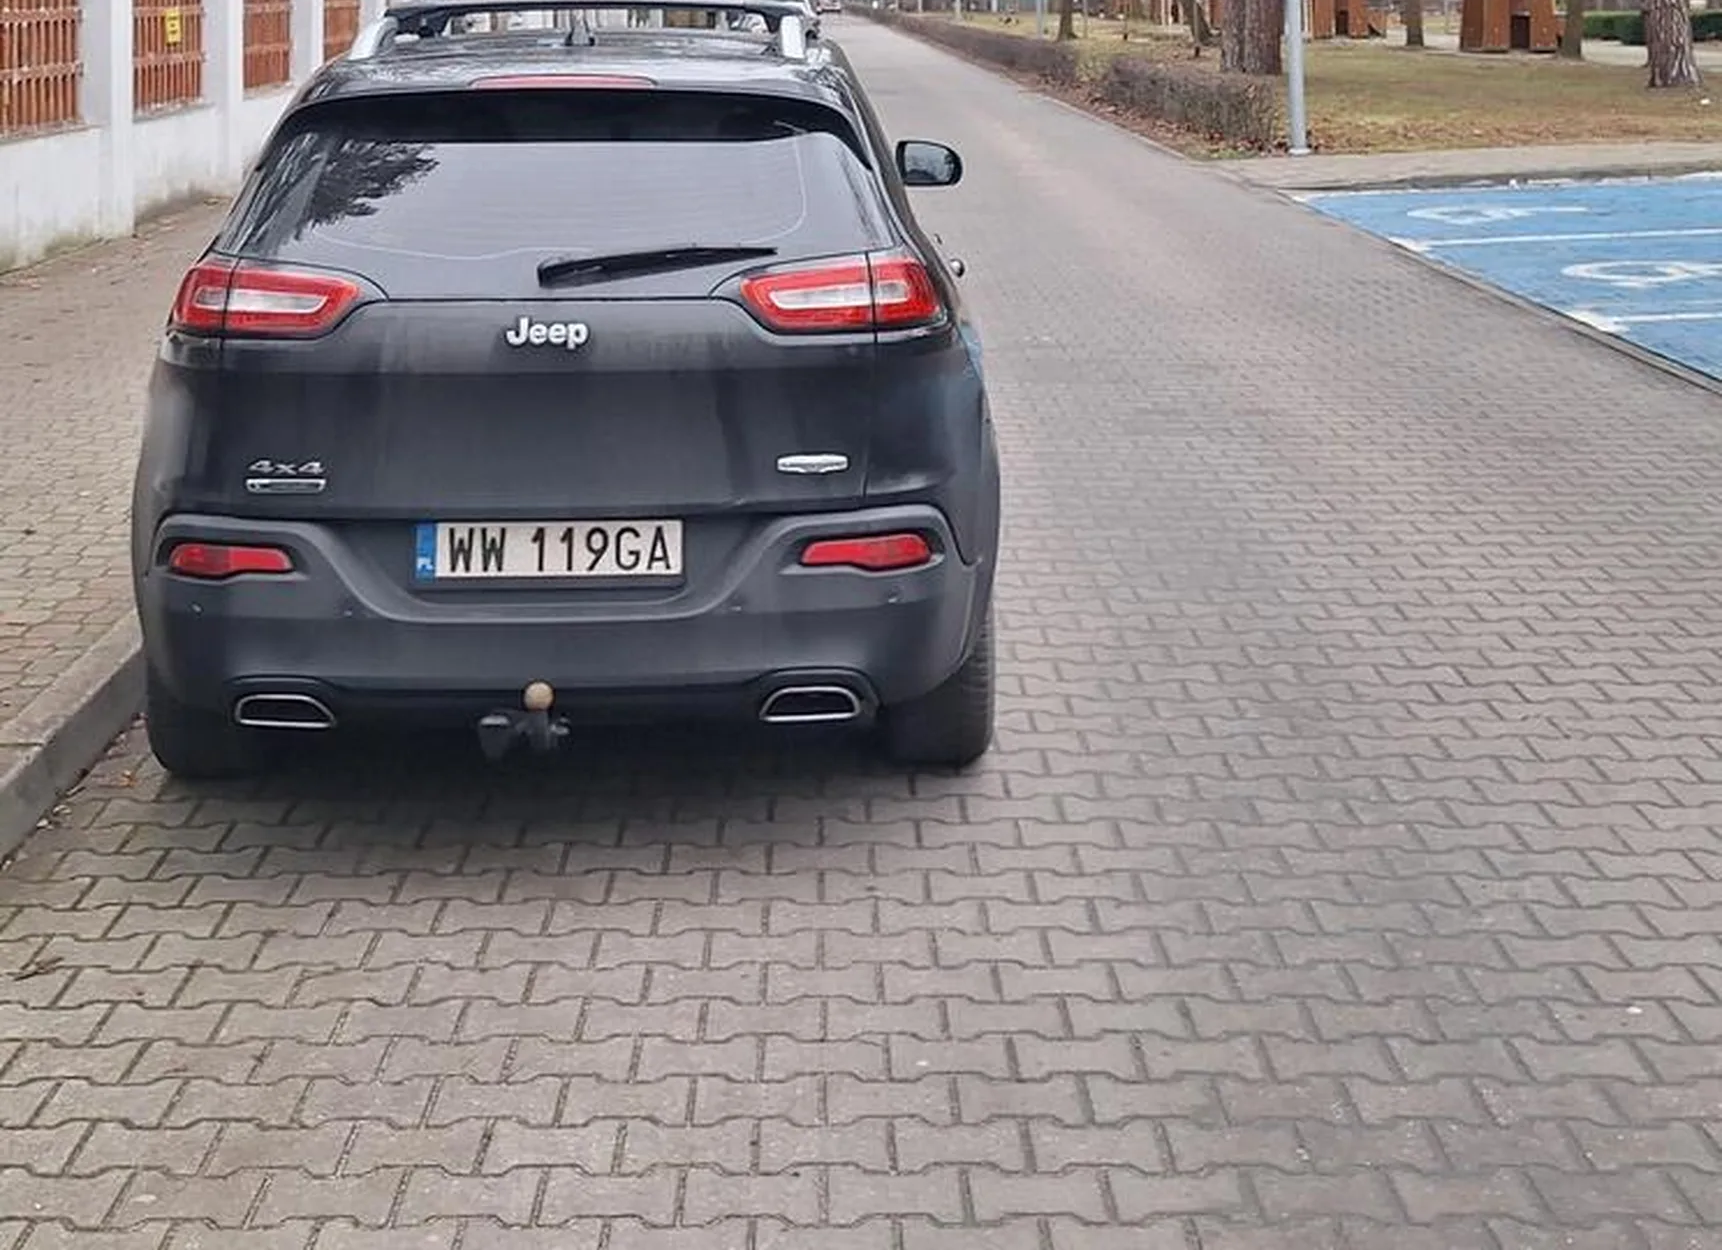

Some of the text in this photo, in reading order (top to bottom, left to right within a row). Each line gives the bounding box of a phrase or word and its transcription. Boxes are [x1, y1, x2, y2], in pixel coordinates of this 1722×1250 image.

[506, 317, 588, 350] Jeep
[249, 460, 325, 475] 4x4
[449, 526, 671, 572] WW 119GA
